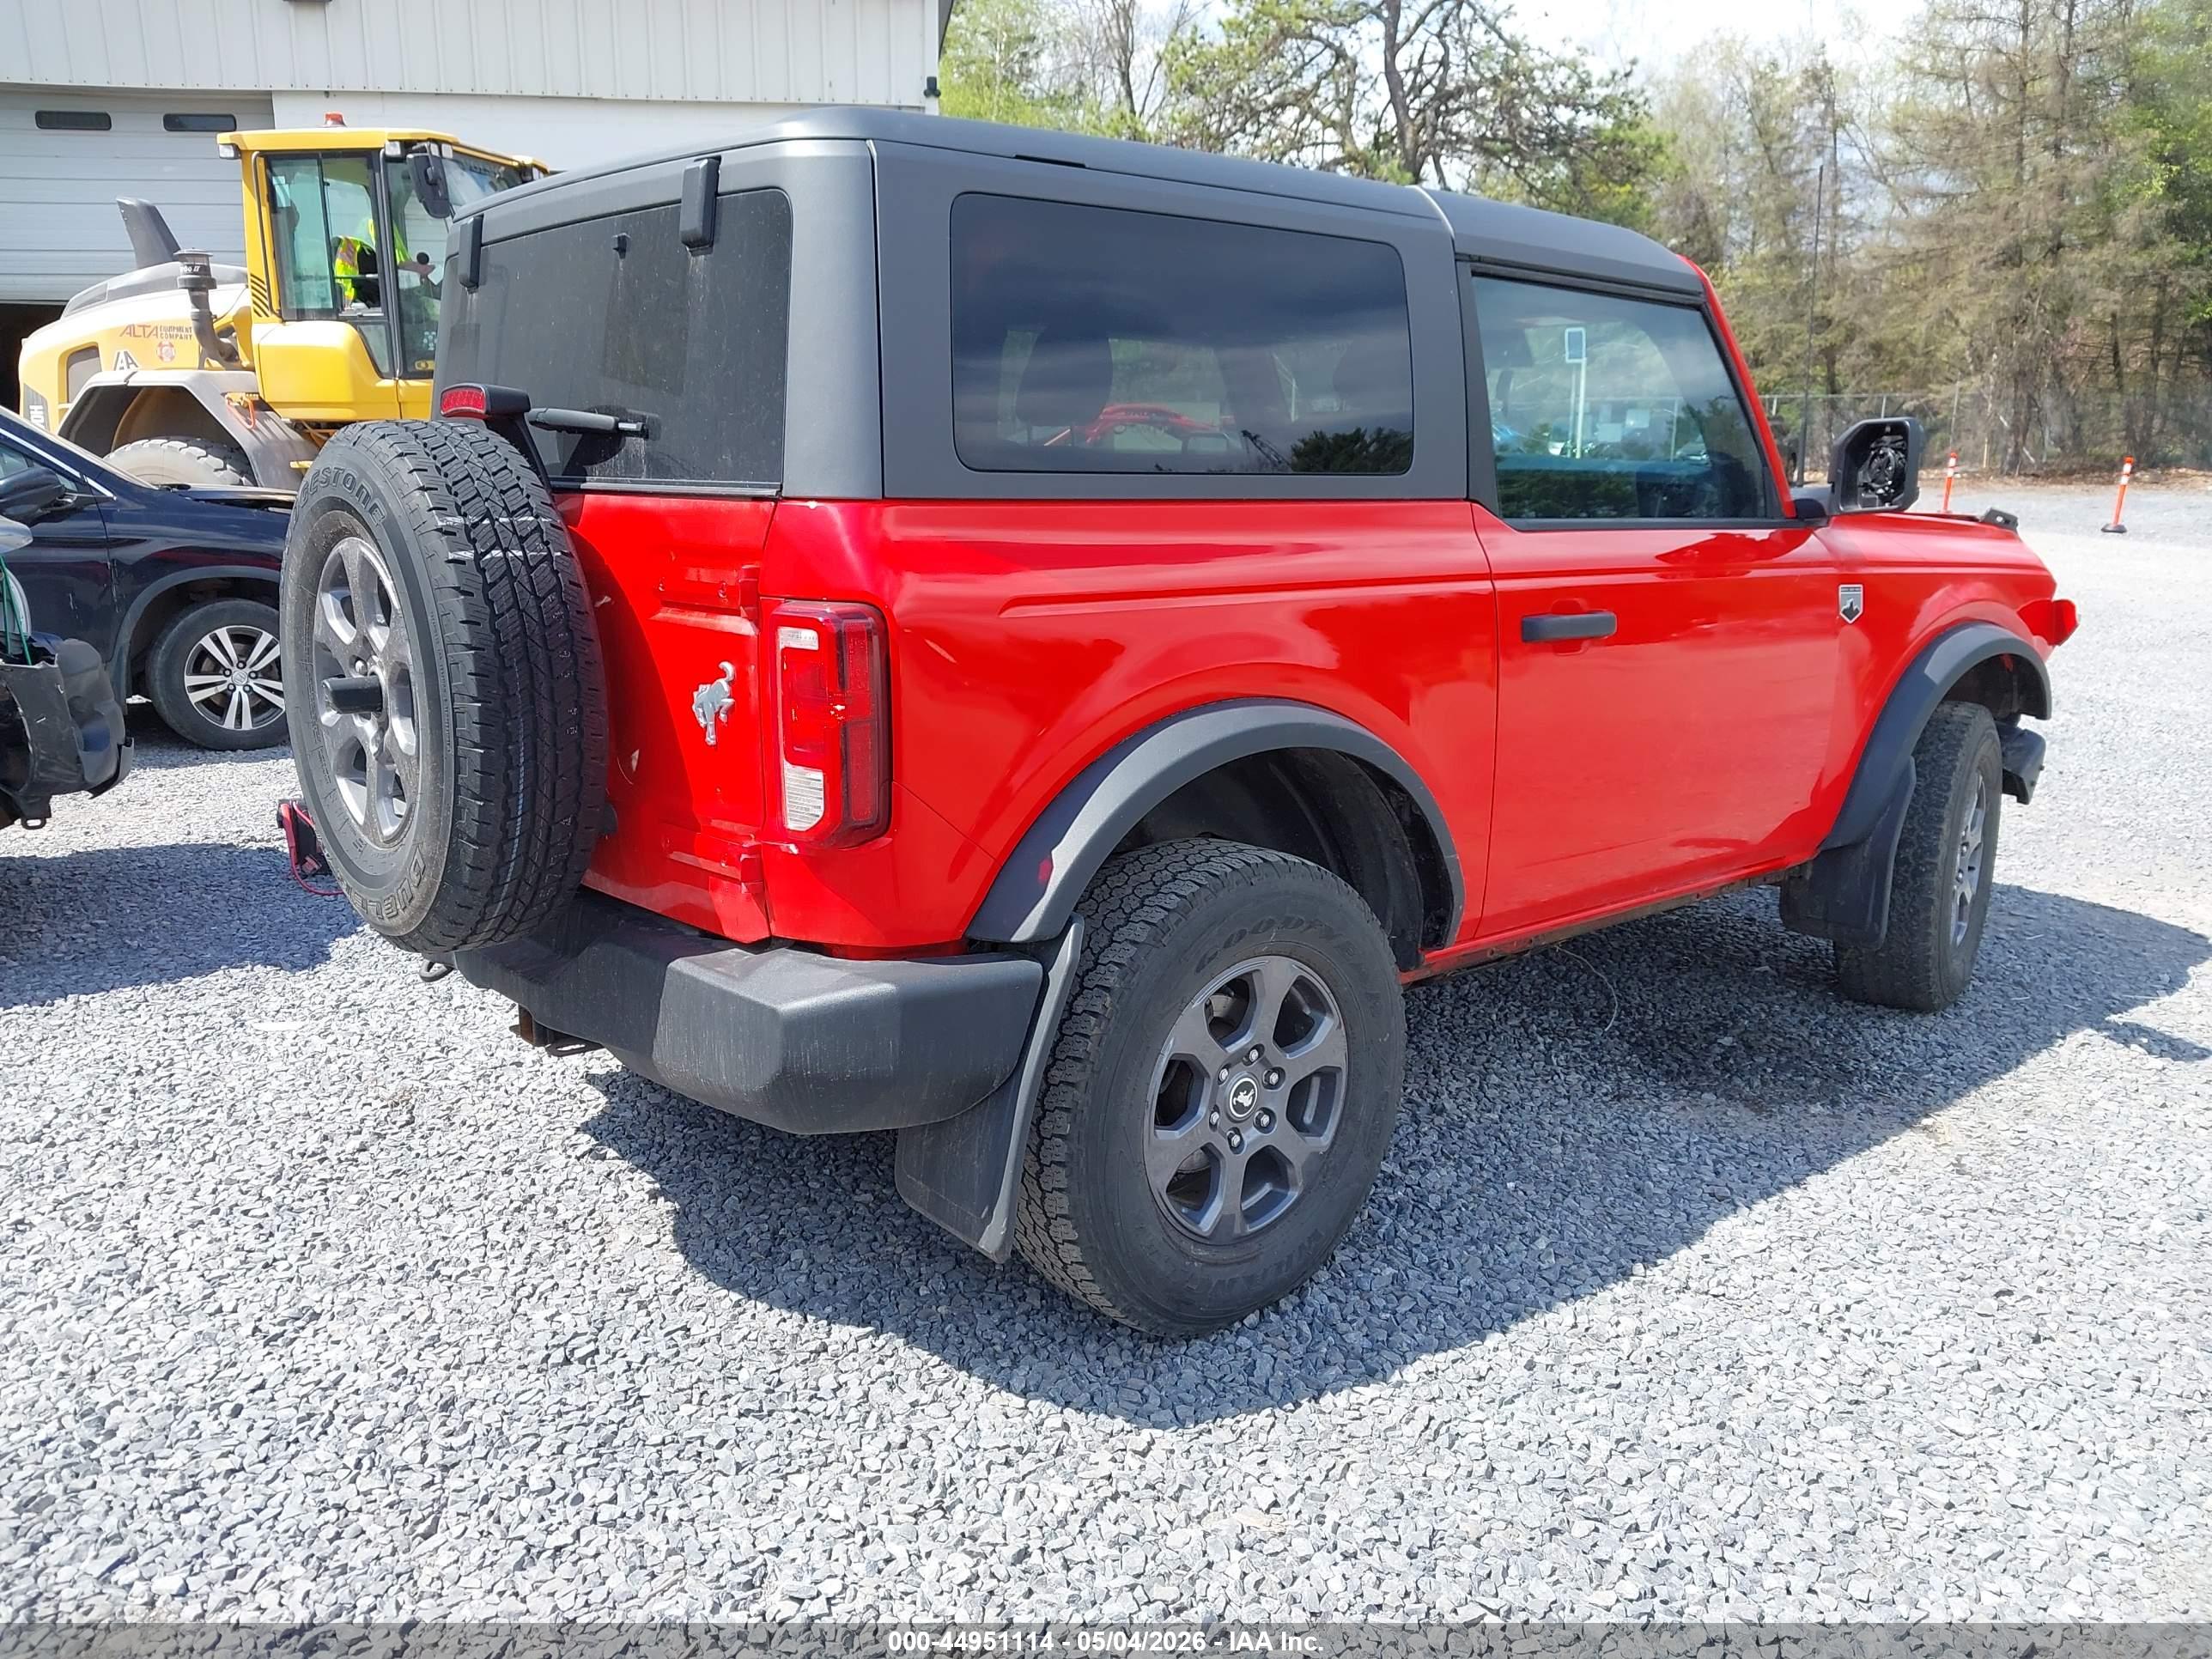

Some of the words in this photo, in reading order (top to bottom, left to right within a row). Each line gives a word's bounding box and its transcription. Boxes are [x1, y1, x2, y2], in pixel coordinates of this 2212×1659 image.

[119, 324, 159, 339] ALTA
[159, 325, 192, 334] EQUIPMENT
[160, 332, 192, 341] COMPANY
